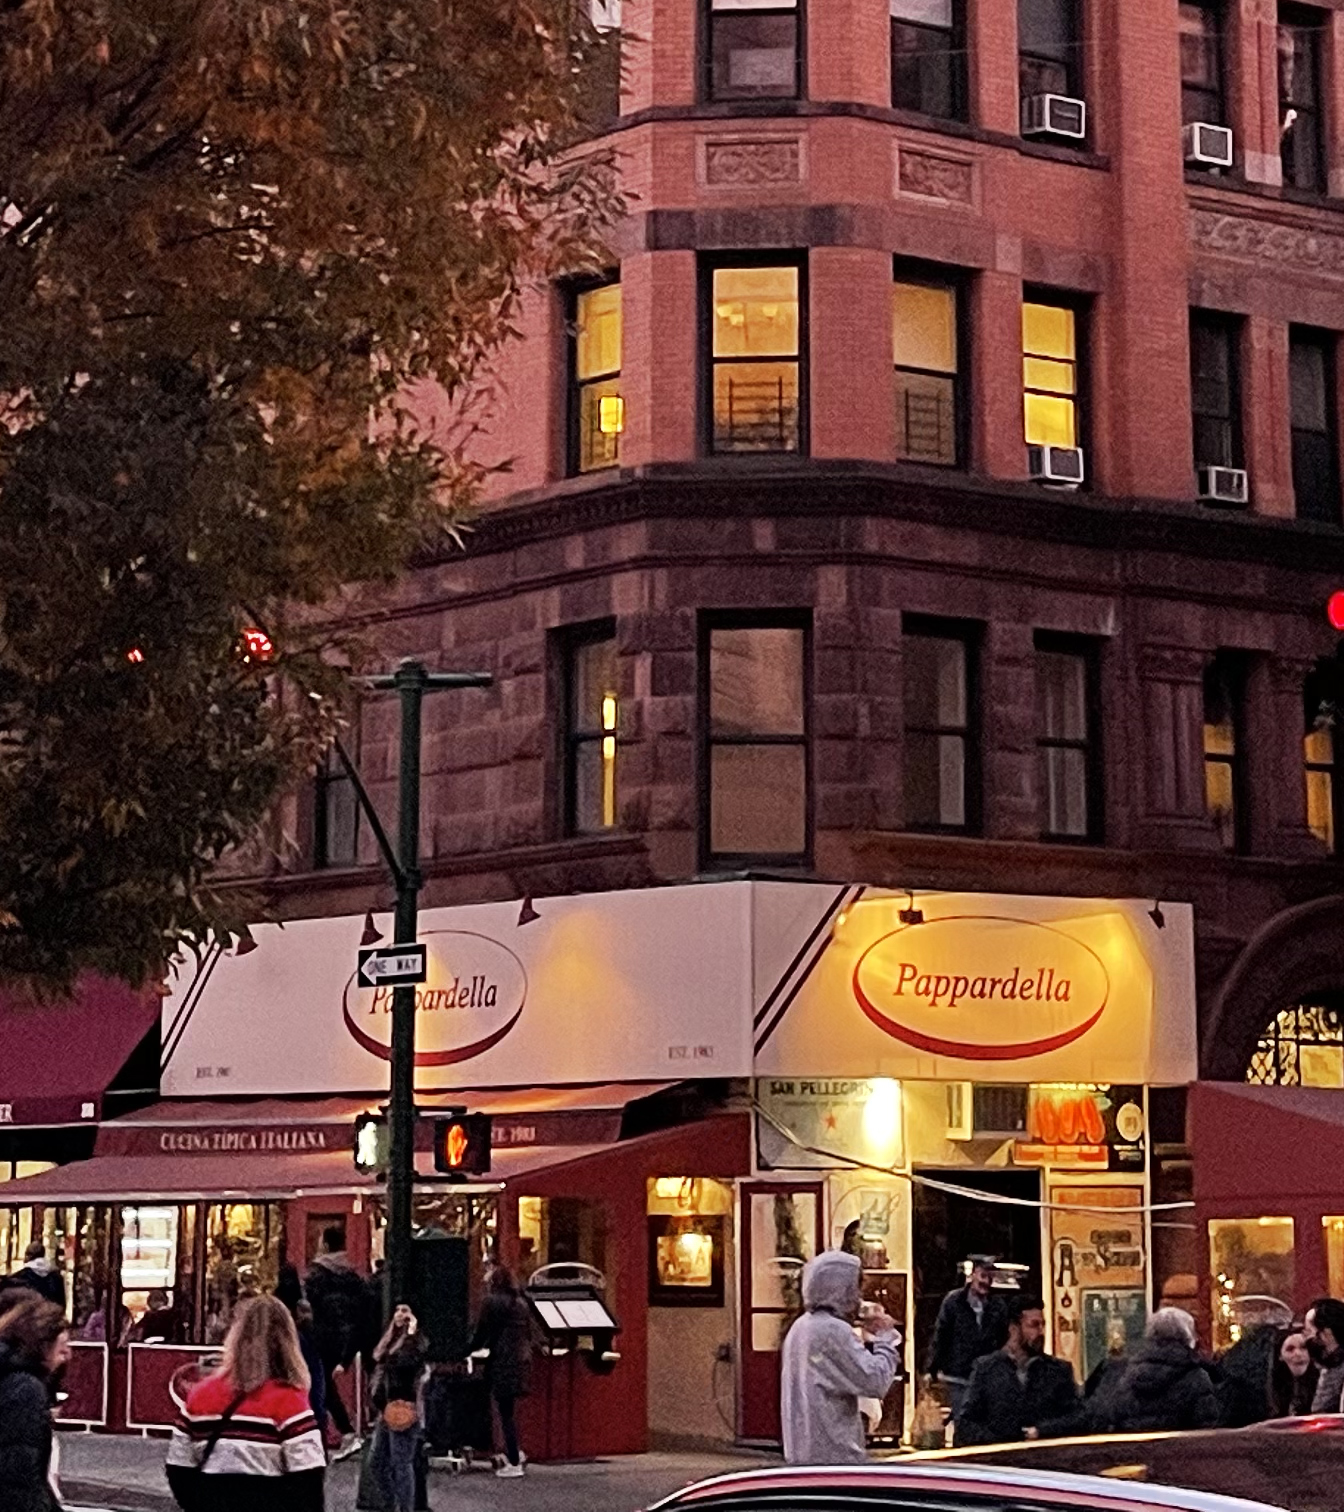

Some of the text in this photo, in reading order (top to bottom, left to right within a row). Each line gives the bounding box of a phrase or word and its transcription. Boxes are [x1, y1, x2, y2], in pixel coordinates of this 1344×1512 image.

[367, 958, 418, 975] ONE WAY
[893, 962, 1071, 1008] Pappardella
[160, 1133, 209, 1150] CUCINA
[260, 1131, 326, 1150] ITALIANA
